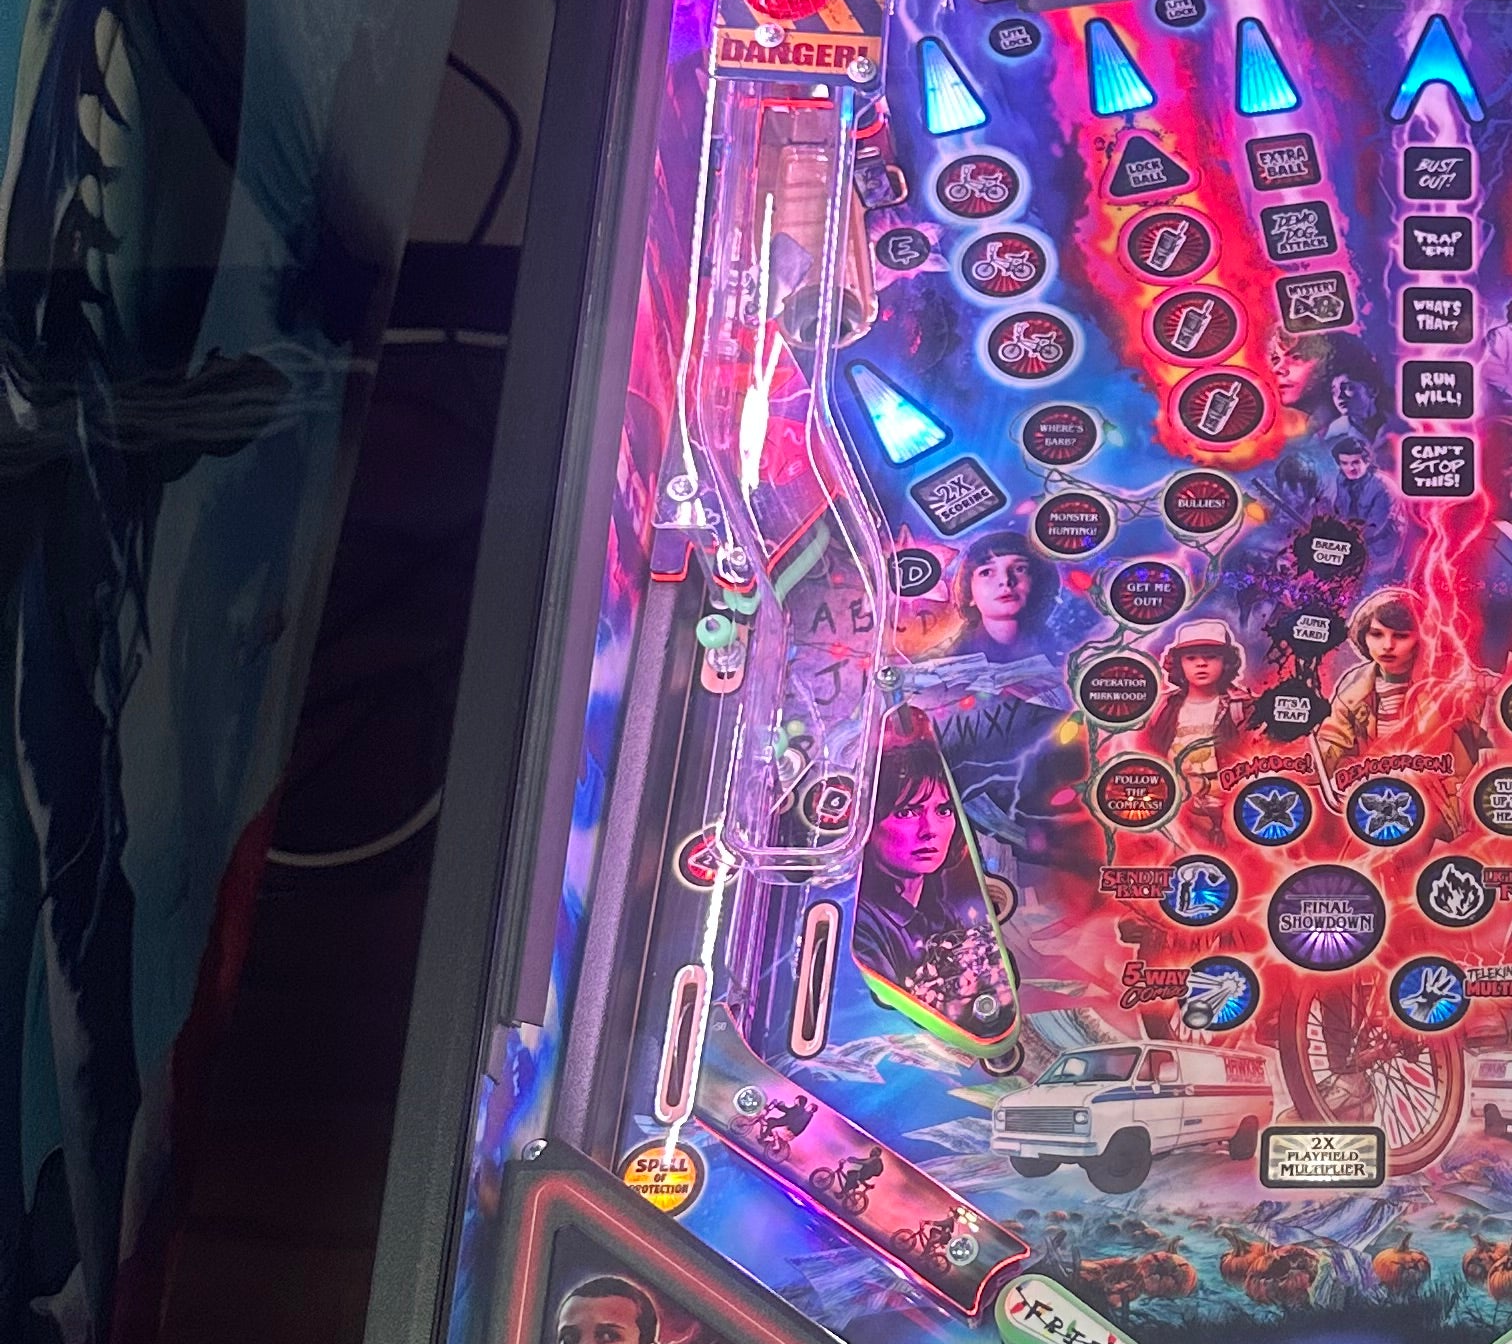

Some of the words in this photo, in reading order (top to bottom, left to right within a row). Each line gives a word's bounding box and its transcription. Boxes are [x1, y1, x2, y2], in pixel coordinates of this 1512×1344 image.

[1166, 7, 1197, 19] LOCK
[1000, 26, 1026, 38] LITE
[1001, 35, 1032, 49] LOCK
[1257, 147, 1308, 167] EXTRA
[1125, 158, 1163, 174] LOCK
[1265, 162, 1308, 178] BALL
[1415, 158, 1462, 174] BUST
[1130, 171, 1167, 187] BALL
[1419, 172, 1456, 190] OUT!
[1272, 209, 1319, 233] DEMO
[1284, 224, 1319, 242] DOG
[1413, 229, 1462, 246] TRAP
[1278, 235, 1329, 254] ATTACK
[1286, 279, 1338, 297] MYSTERY
[1413, 299, 1462, 318] WHAT'S
[1416, 314, 1458, 332] THAT?
[1420, 372, 1457, 388] RUN
[1415, 389, 1462, 408] WILL!
[1040, 423, 1085, 434] WHERE'S
[1044, 436, 1077, 448] BARB?
[1411, 445, 1464, 459] CAN'T
[1409, 459, 1465, 475] STOP
[1414, 474, 1461, 489] THIS!
[933, 474, 975, 505] 2X
[938, 487, 992, 522] SCORING
[1178, 498, 1226, 509] BULLIES!
[1050, 512, 1100, 523] MONSTER
[1047, 525, 1099, 537] HUNTING!
[1312, 537, 1351, 555] BREAK
[1314, 550, 1345, 566] OUT!
[1127, 582, 1152, 593] GET
[1154, 582, 1173, 593] ME
[1132, 595, 1164, 607] OUT!
[1299, 615, 1331, 630] JUNK
[1293, 626, 1330, 643] YARD!
[1091, 678, 1147, 689] OPERATION
[1089, 691, 1148, 701] MIRKWOOD!
[1275, 696, 1297, 709] IT'S
[1299, 697, 1311, 709] A
[1274, 709, 1310, 723] TRAP!
[1219, 753, 1314, 791] DEMODOG!
[1335, 754, 1455, 791] DEMOGORGON!
[1114, 775, 1160, 785] FOLLOW
[1126, 787, 1147, 797] THE
[1107, 799, 1163, 811] COMPASS!
[1491, 795, 1510, 808] UP
[1102, 868, 1151, 889] SEND
[1153, 868, 1175, 887] IT
[1115, 884, 1164, 898] BACK
[1302, 900, 1353, 915] FINAL
[1280, 913, 1374, 932] SHOWDOWN
[1311, 1137, 1336, 1150] 2X
[1287, 1151, 1359, 1162] PLAYFIELD
[635, 1158, 688, 1173] SPELL
[1280, 1163, 1366, 1177] MULTIPLIER
[653, 1173, 667, 1183] OF
